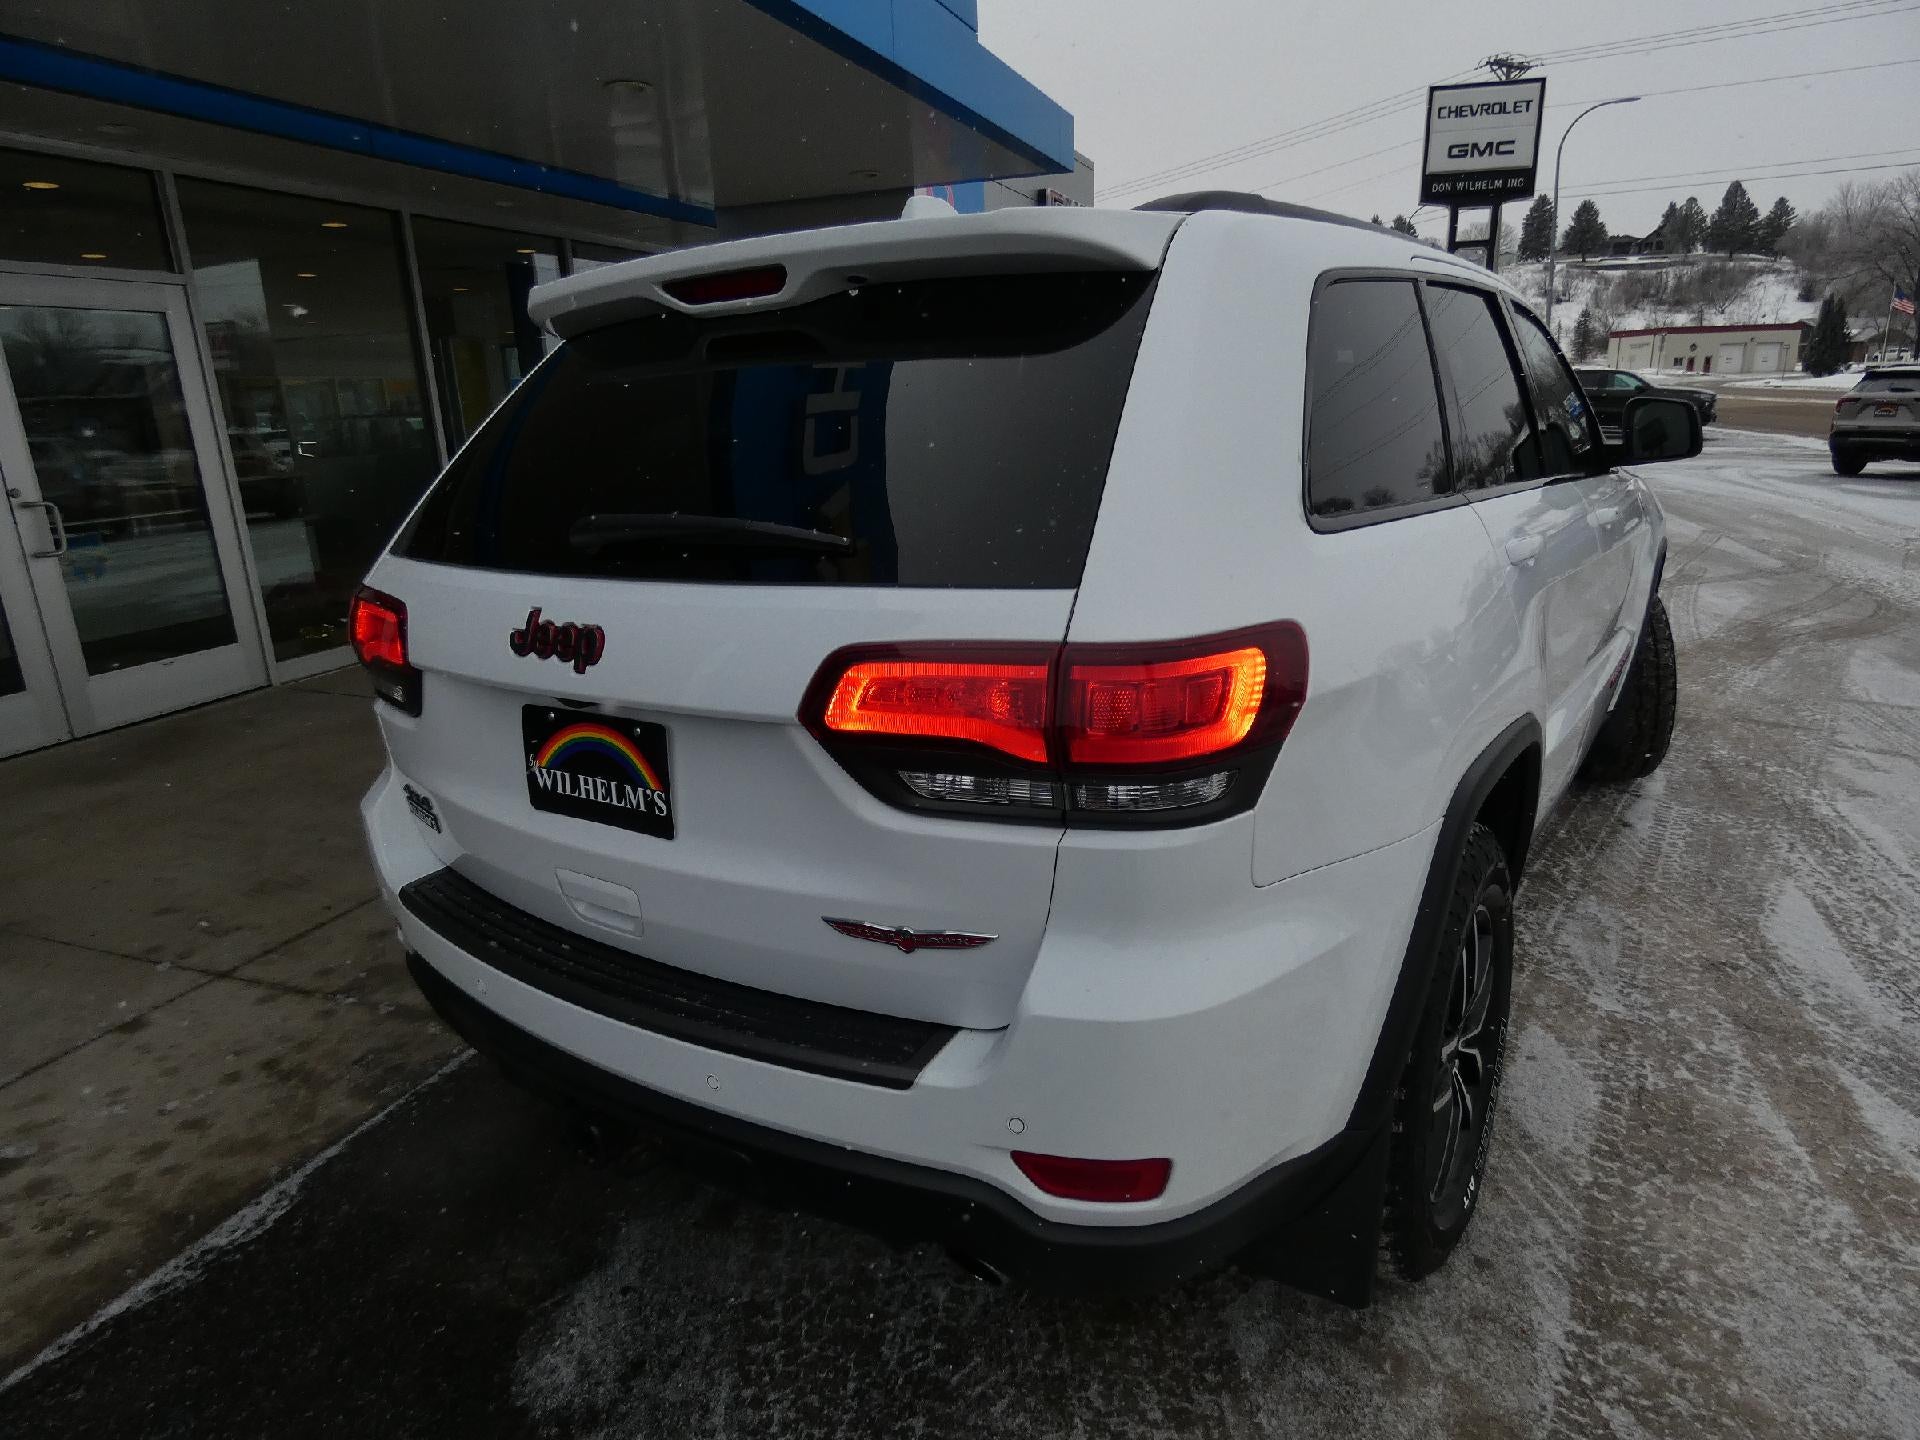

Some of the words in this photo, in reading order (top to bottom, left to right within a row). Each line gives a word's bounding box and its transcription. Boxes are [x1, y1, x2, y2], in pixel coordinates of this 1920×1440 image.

[1437, 100, 1533, 119] CHEVROLET
[1447, 140, 1516, 159] GMC
[1431, 182, 1452, 193] DON
[1456, 179, 1503, 191] WILHELM
[1507, 177, 1525, 188] INC
[509, 606, 606, 675] Jeep
[534, 766, 667, 817] WILHELM'S
